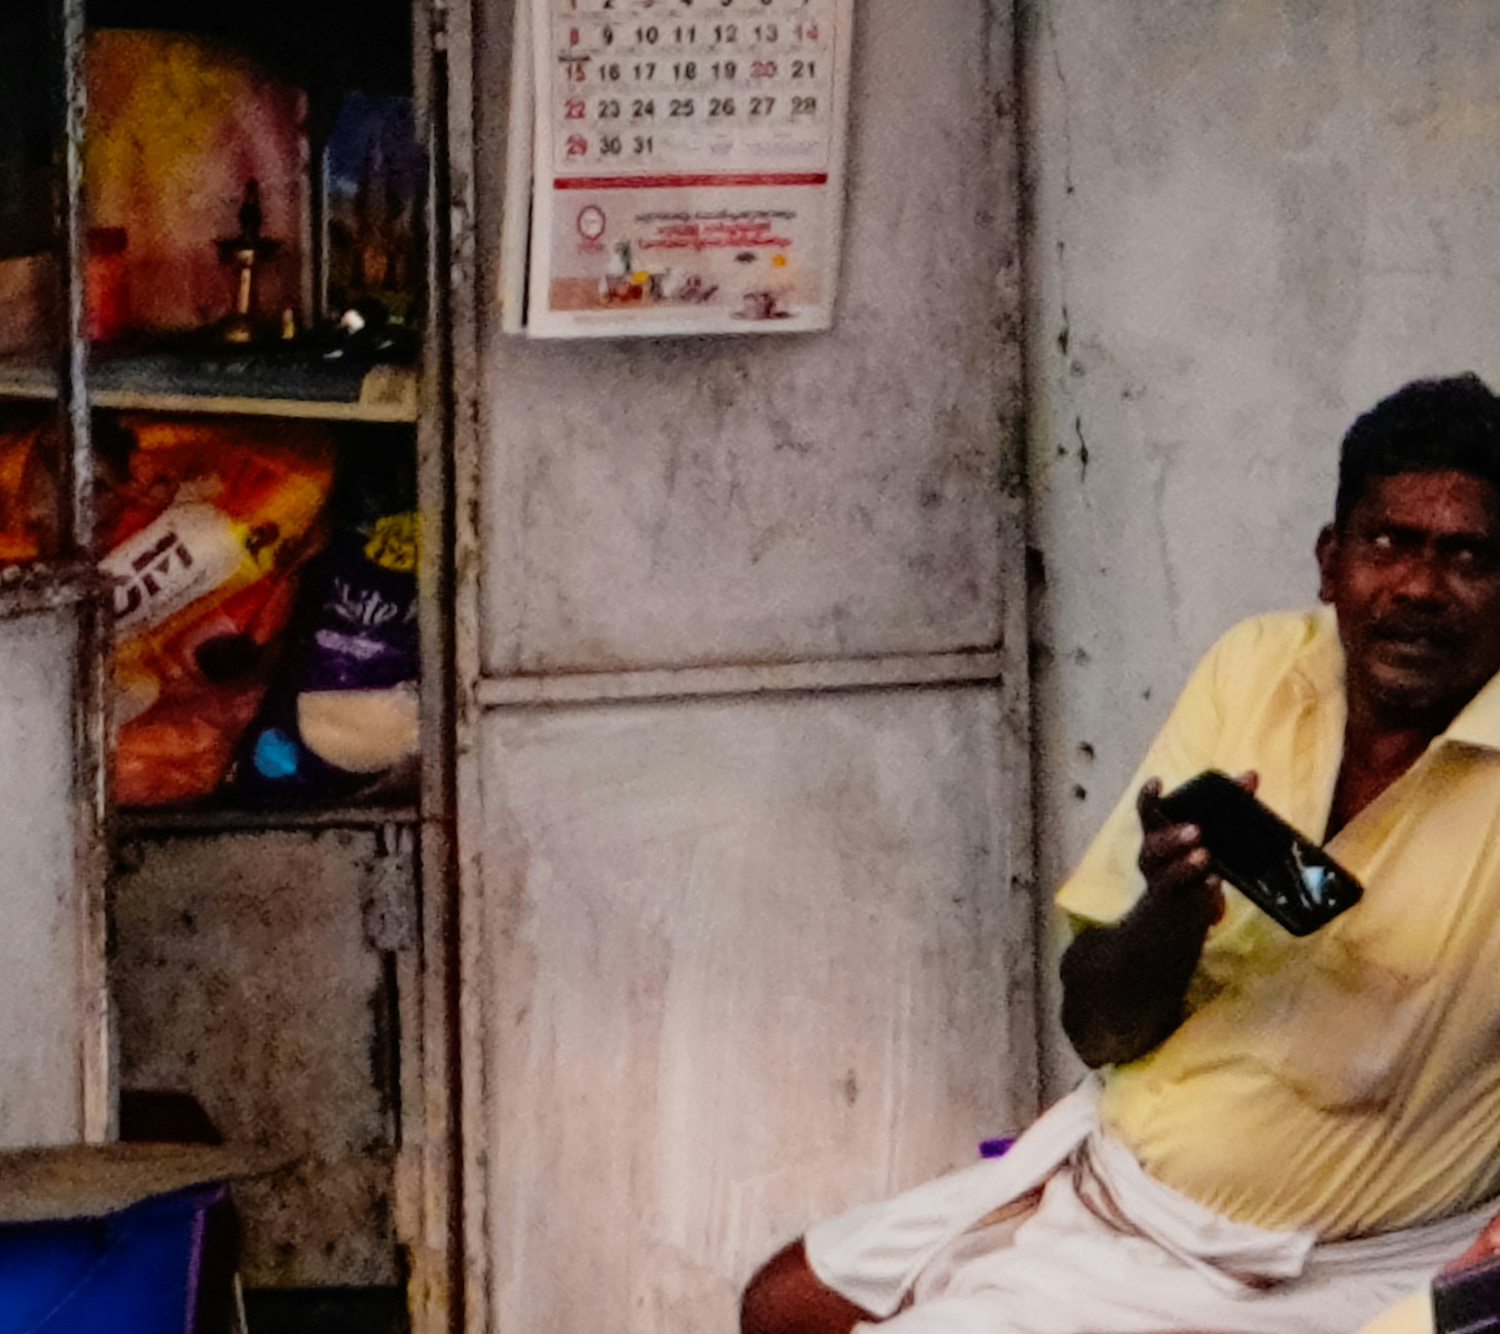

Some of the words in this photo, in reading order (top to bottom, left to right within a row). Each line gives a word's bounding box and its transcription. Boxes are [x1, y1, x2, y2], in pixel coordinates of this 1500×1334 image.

[603, 25, 614, 45] 9
[635, 25, 659, 44] 10
[674, 25, 696, 43] 11
[714, 24, 738, 43] 12
[754, 24, 778, 42] 13
[599, 63, 621, 81] 16
[633, 62, 656, 80] 17
[711, 61, 738, 80] 19
[791, 60, 815, 78] 21
[564, 99, 586, 119] 22
[598, 99, 621, 118] 23
[631, 99, 655, 117] 24
[669, 98, 695, 117] 25
[709, 97, 735, 116] 26
[750, 96, 776, 115] 27
[600, 136, 622, 155] 30
[633, 136, 654, 155] 31
